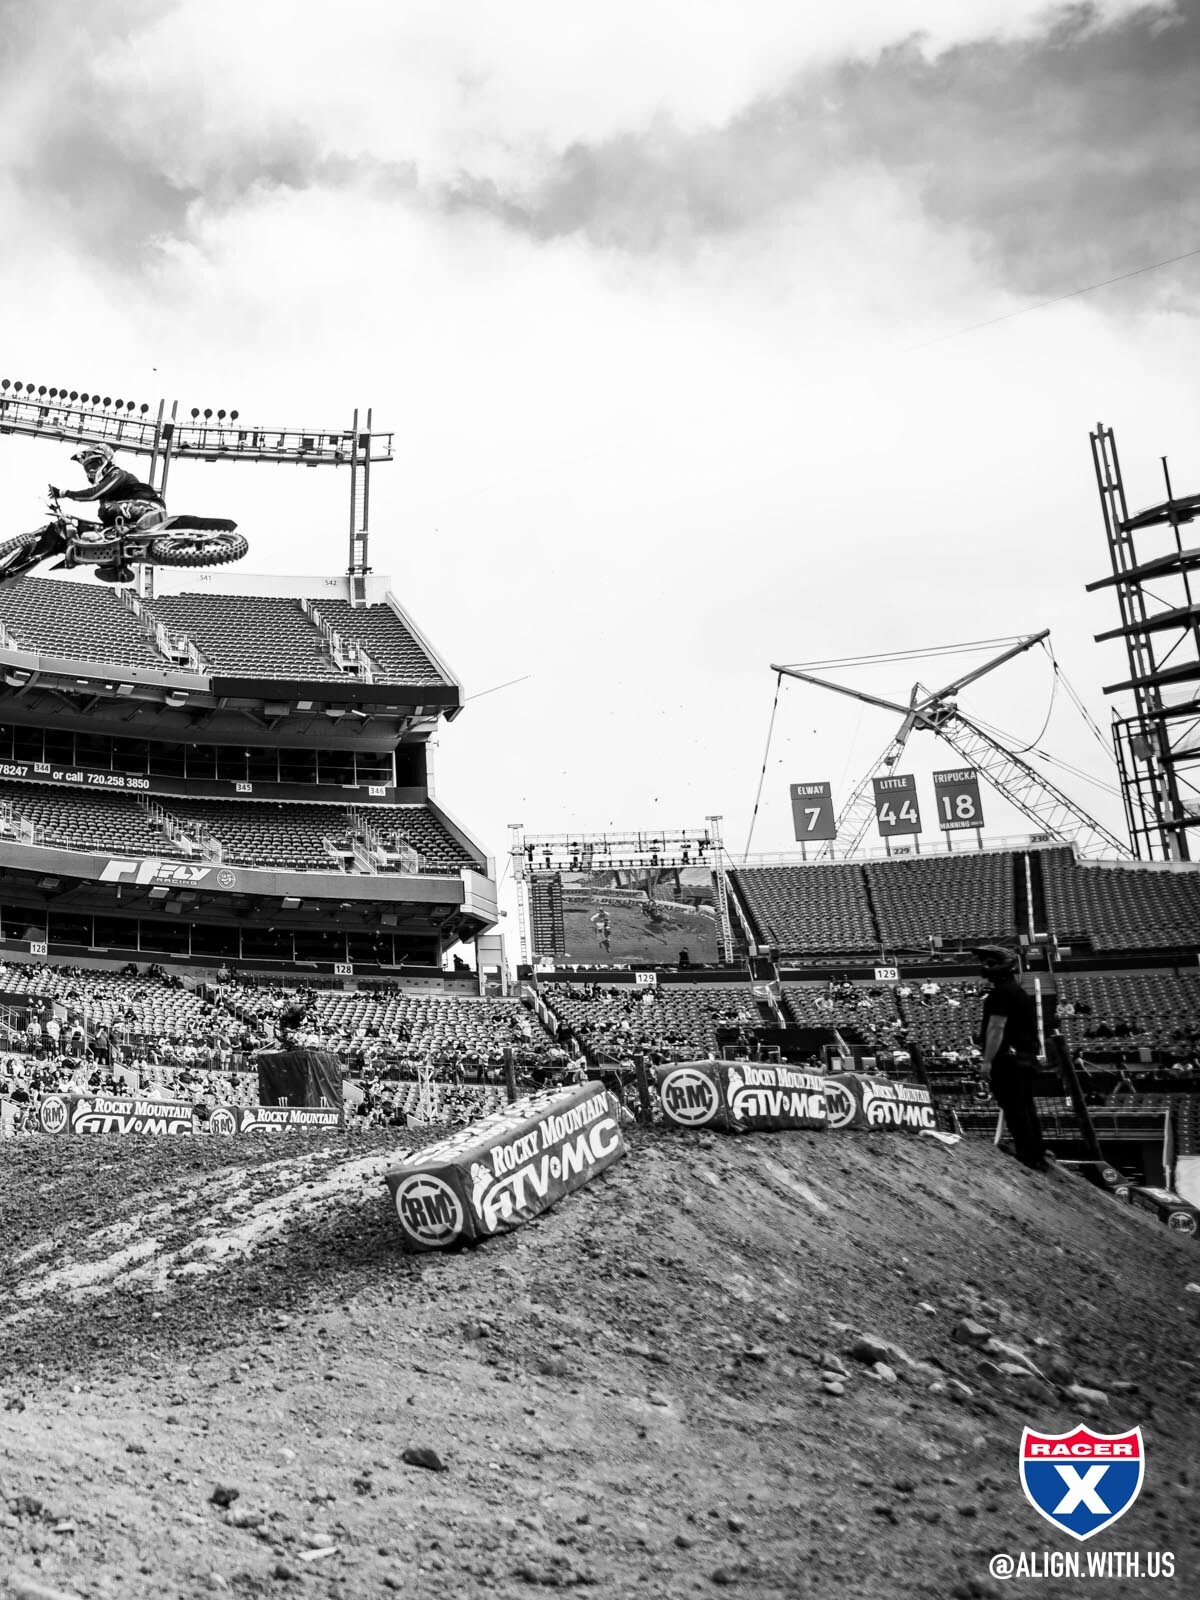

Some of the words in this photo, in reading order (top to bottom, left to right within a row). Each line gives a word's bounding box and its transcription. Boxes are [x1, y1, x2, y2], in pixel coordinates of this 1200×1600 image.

[35, 763, 49, 772] 344
[52, 770, 65, 780] or
[65, 771, 84, 782] call
[87, 773, 125, 786] 720.258
[126, 778, 150, 789] 3850
[933, 771, 977, 783] TRIPUCKA
[237, 783, 251, 791] 345
[879, 778, 908, 789] LITTLE
[370, 787, 384, 795] 346
[797, 785, 824, 795] ELWAY
[942, 795, 976, 820] 18
[878, 800, 918, 826] 44
[804, 807, 821, 831] 7
[939, 821, 970, 829] MANNING
[894, 847, 910, 855] 229
[156, 877, 198, 886] RACING
[33, 944, 46, 953] 128
[336, 965, 351, 974] 128
[878, 969, 896, 978] 129
[638, 974, 654, 983] 129
[743, 1065, 776, 1086] ROCKY
[94, 1098, 133, 1115] ROCKY
[134, 1101, 192, 1119] MOUNTAIN
[257, 1109, 288, 1123] ROCKY
[288, 1109, 338, 1125] MOUNTAIN
[490, 1131, 539, 1177] ROCKY
[539, 1091, 609, 1150] MOUNTAIN
